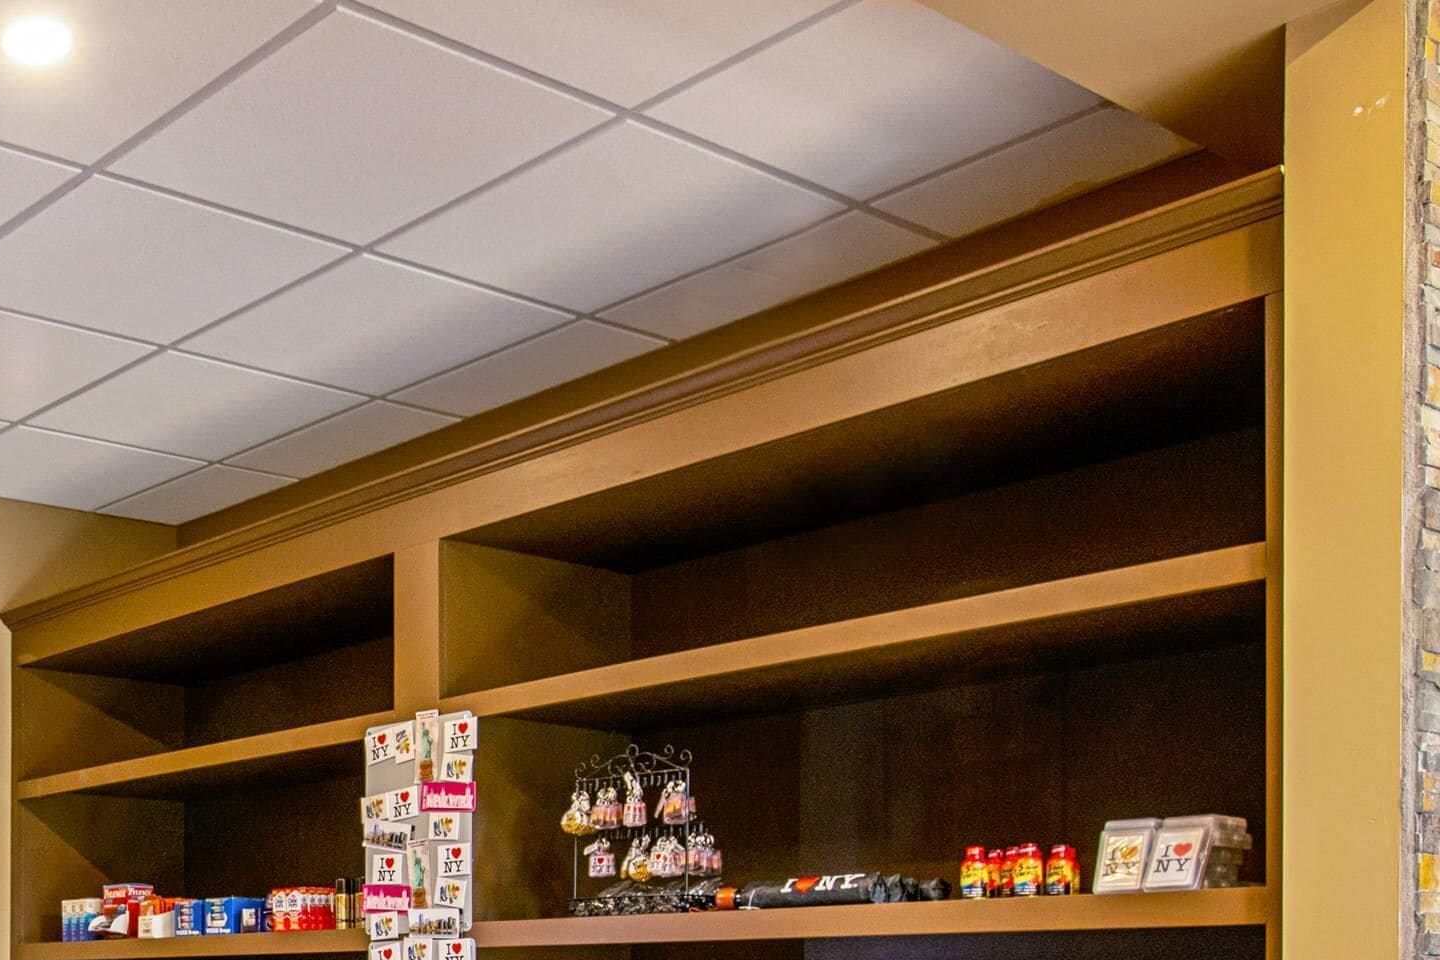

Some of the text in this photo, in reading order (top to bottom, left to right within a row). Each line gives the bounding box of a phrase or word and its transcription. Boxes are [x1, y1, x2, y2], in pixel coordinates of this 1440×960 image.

[452, 723, 457, 736] I
[372, 736, 377, 748] I
[450, 734, 470, 749] NY
[371, 744, 389, 760] NY
[394, 793, 399, 804] I
[393, 803, 411, 817] NY
[446, 848, 450, 860] I
[1109, 848, 1119, 860] I
[1161, 844, 1173, 858] I
[380, 858, 384, 868] I
[444, 860, 464, 873] NY
[1102, 861, 1141, 876] NY
[1154, 858, 1191, 873] NY
[378, 870, 396, 882] NY
[780, 874, 866, 893] I NY
[446, 944, 450, 955] I
